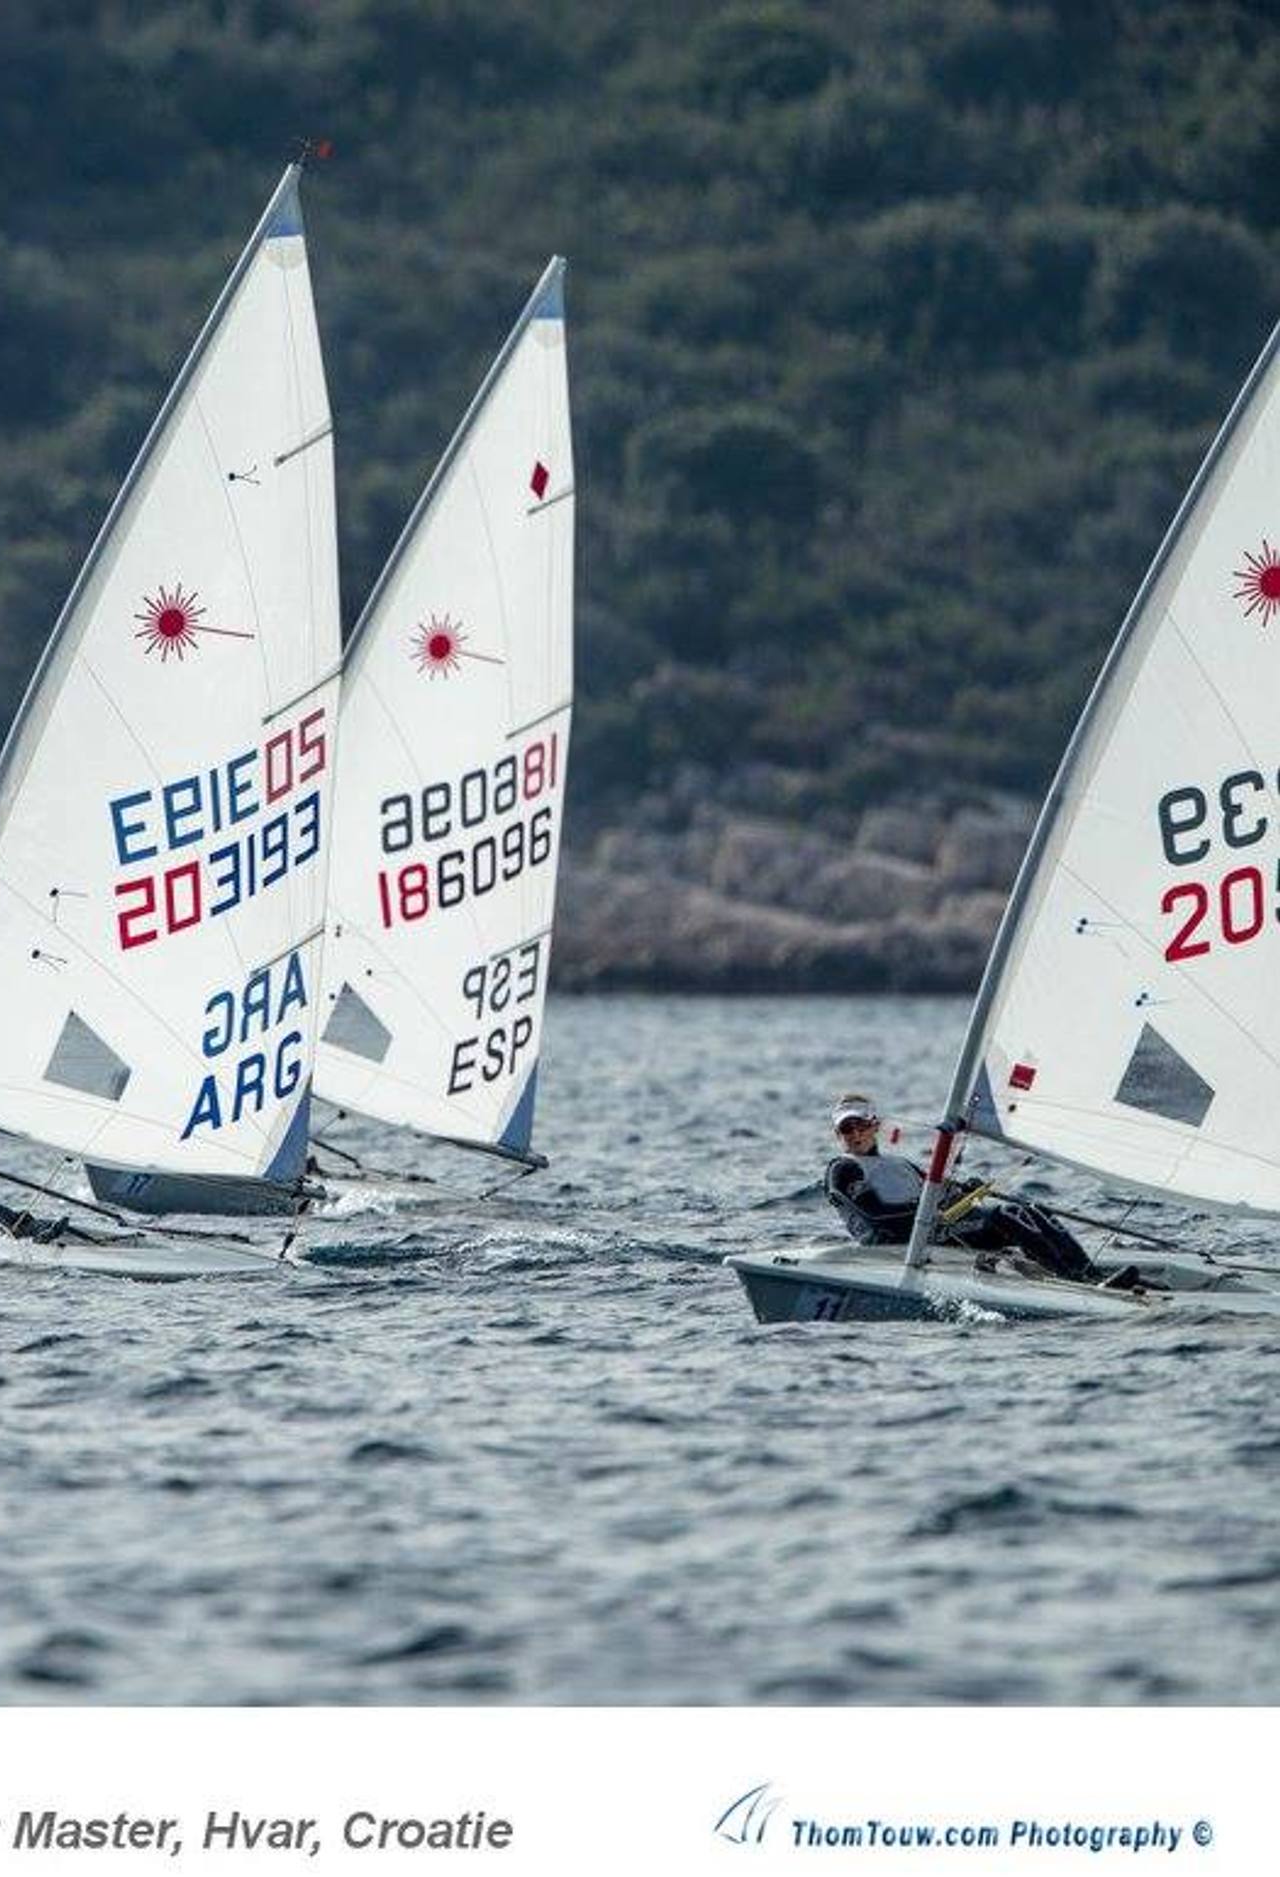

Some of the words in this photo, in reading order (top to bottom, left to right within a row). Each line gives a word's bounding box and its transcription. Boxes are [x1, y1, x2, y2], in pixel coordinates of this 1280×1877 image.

[114, 790, 321, 950] 203193
[378, 806, 551, 929] 186096
[1161, 858, 1280, 963] 20
[179, 1030, 304, 1142] ARG
[446, 1014, 533, 1096] ESP
